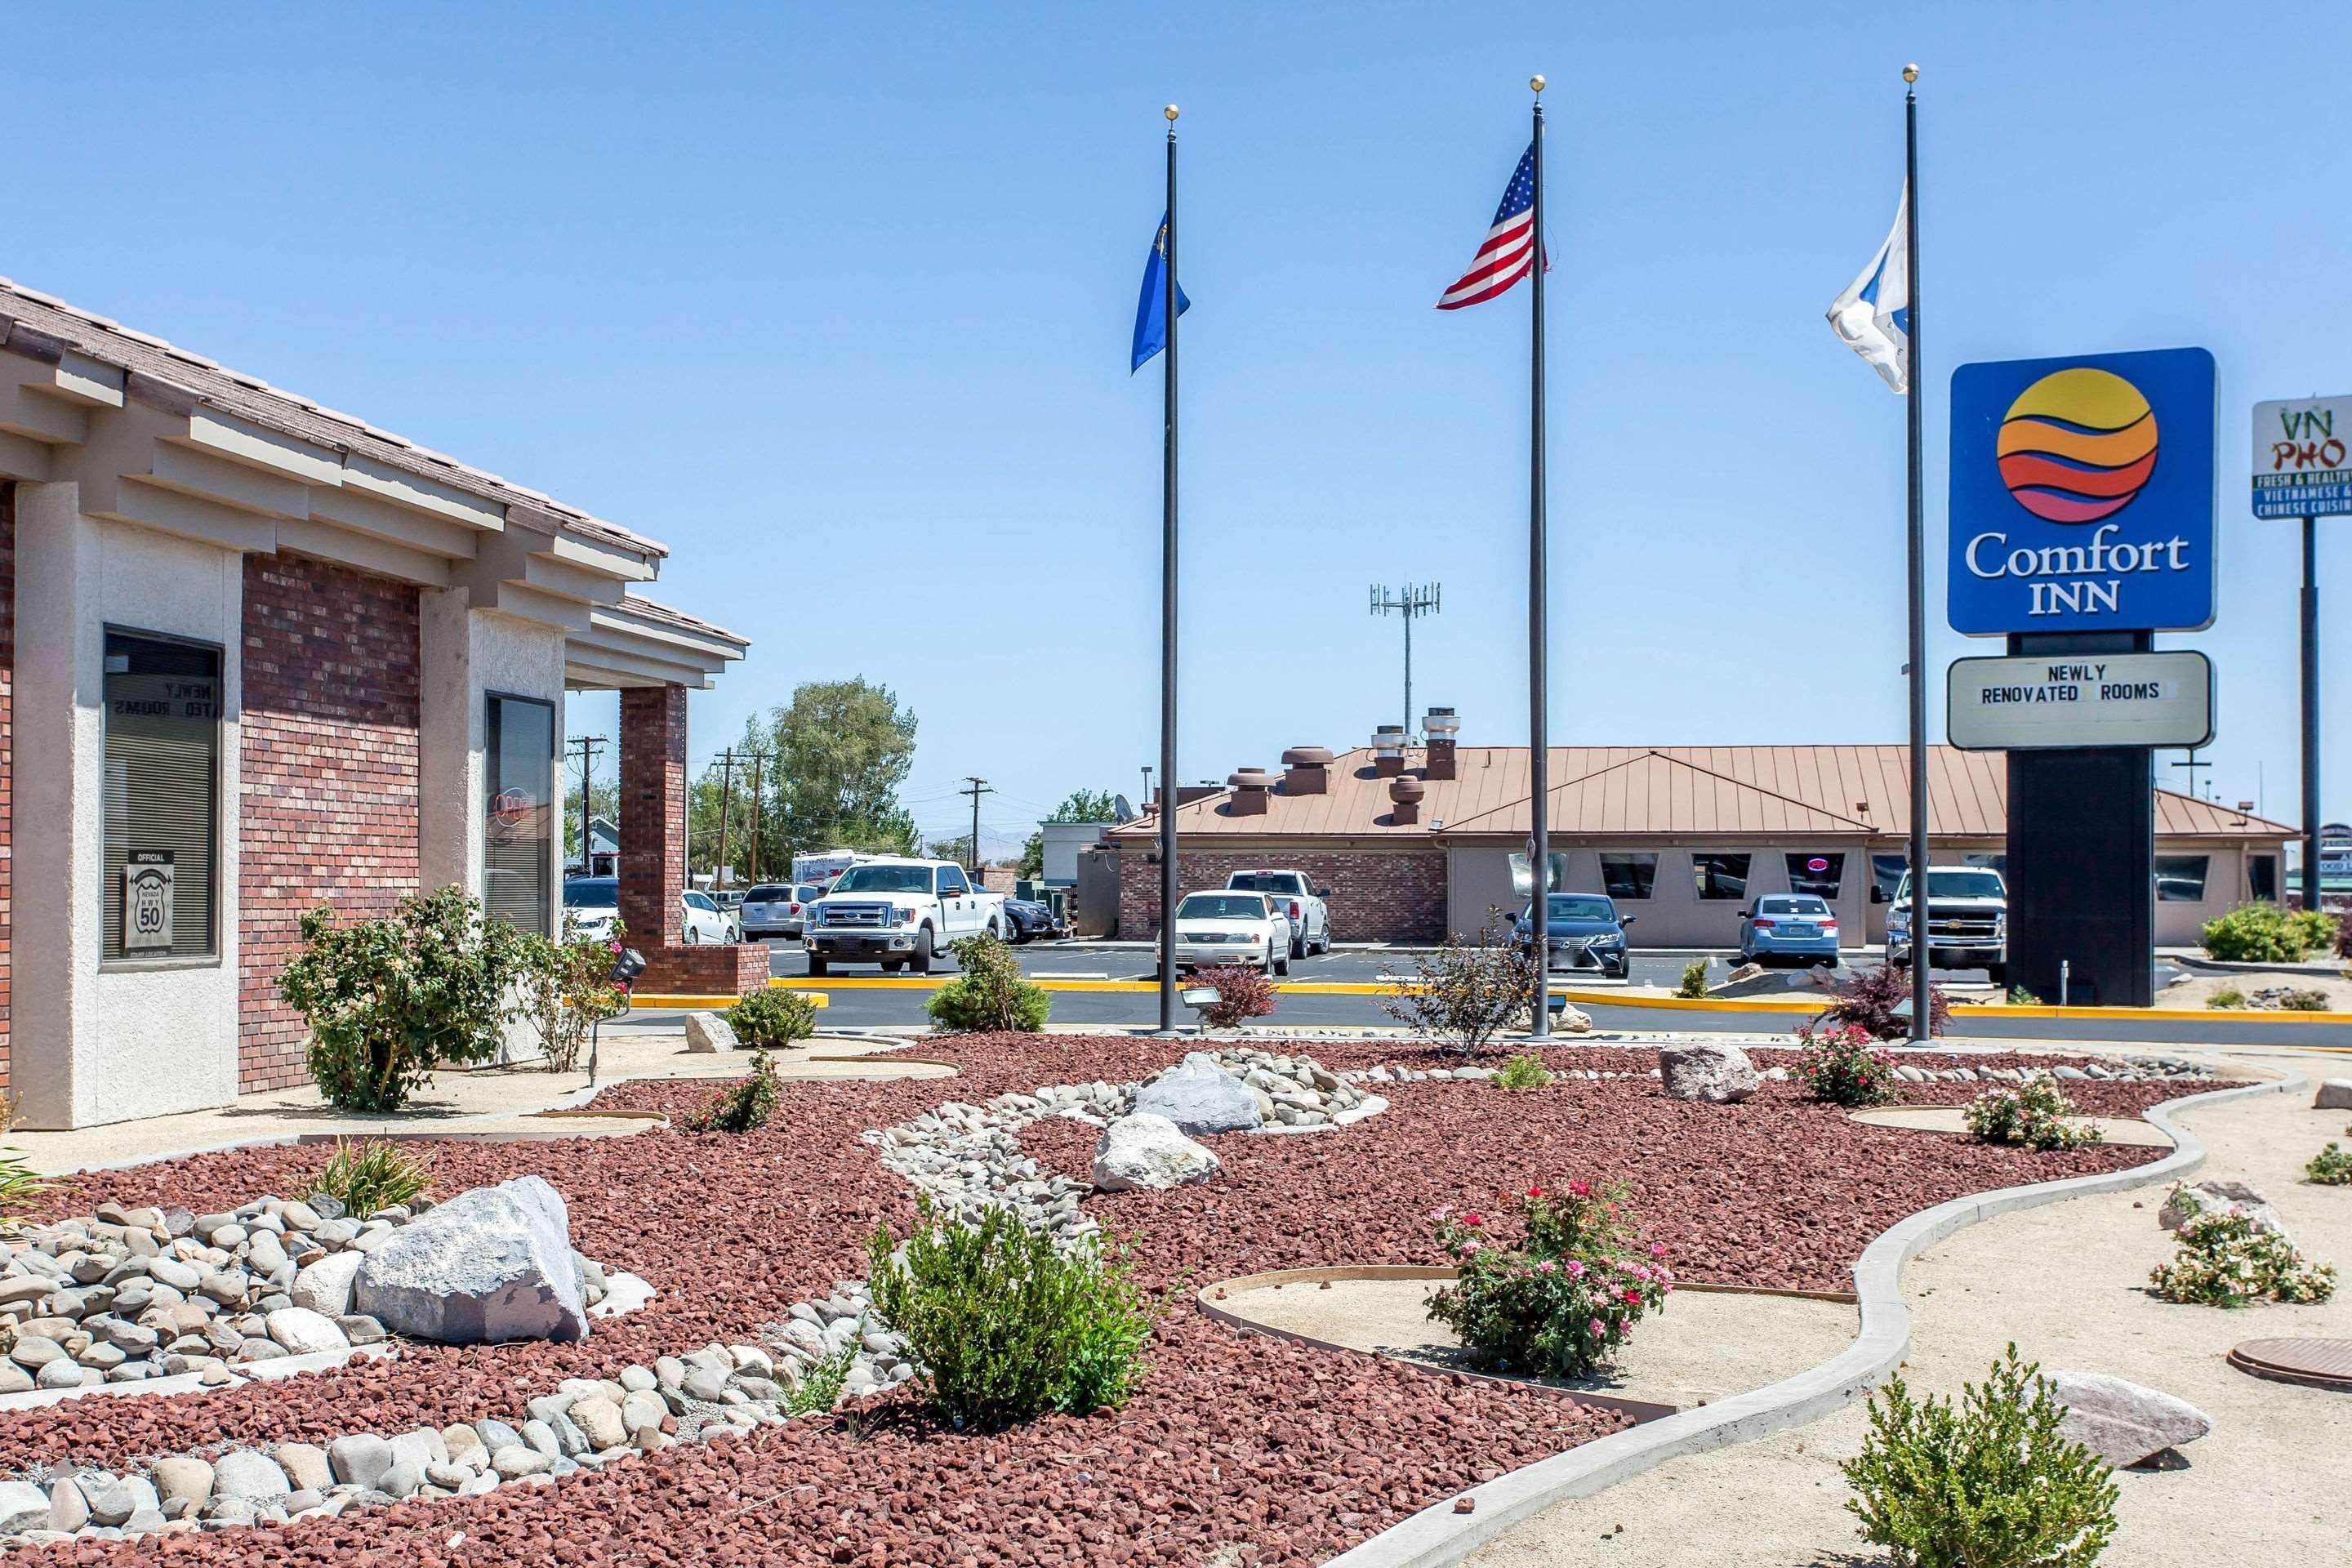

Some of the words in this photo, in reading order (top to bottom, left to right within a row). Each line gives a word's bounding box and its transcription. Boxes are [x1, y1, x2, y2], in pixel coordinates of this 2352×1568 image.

[2280, 409, 2332, 440] VN
[2271, 439, 2346, 471] PHO
[2257, 474, 2292, 488] FRESH
[2296, 474, 2305, 486] &
[2307, 470, 2352, 485] HEALTH
[2264, 486, 2339, 502] VIETNAMESE
[2257, 501, 2307, 516] CHINESE
[2311, 499, 2352, 514] CUISIN
[1965, 523, 2189, 579] Comfort
[2028, 580, 2121, 616] INN
[2048, 664, 2107, 683] NEWLY
[1981, 685, 2078, 704] RENOVATED
[2100, 683, 2160, 701] ROOMS
[137, 853, 165, 862] OFFICIAL
[140, 906, 160, 927] 50
